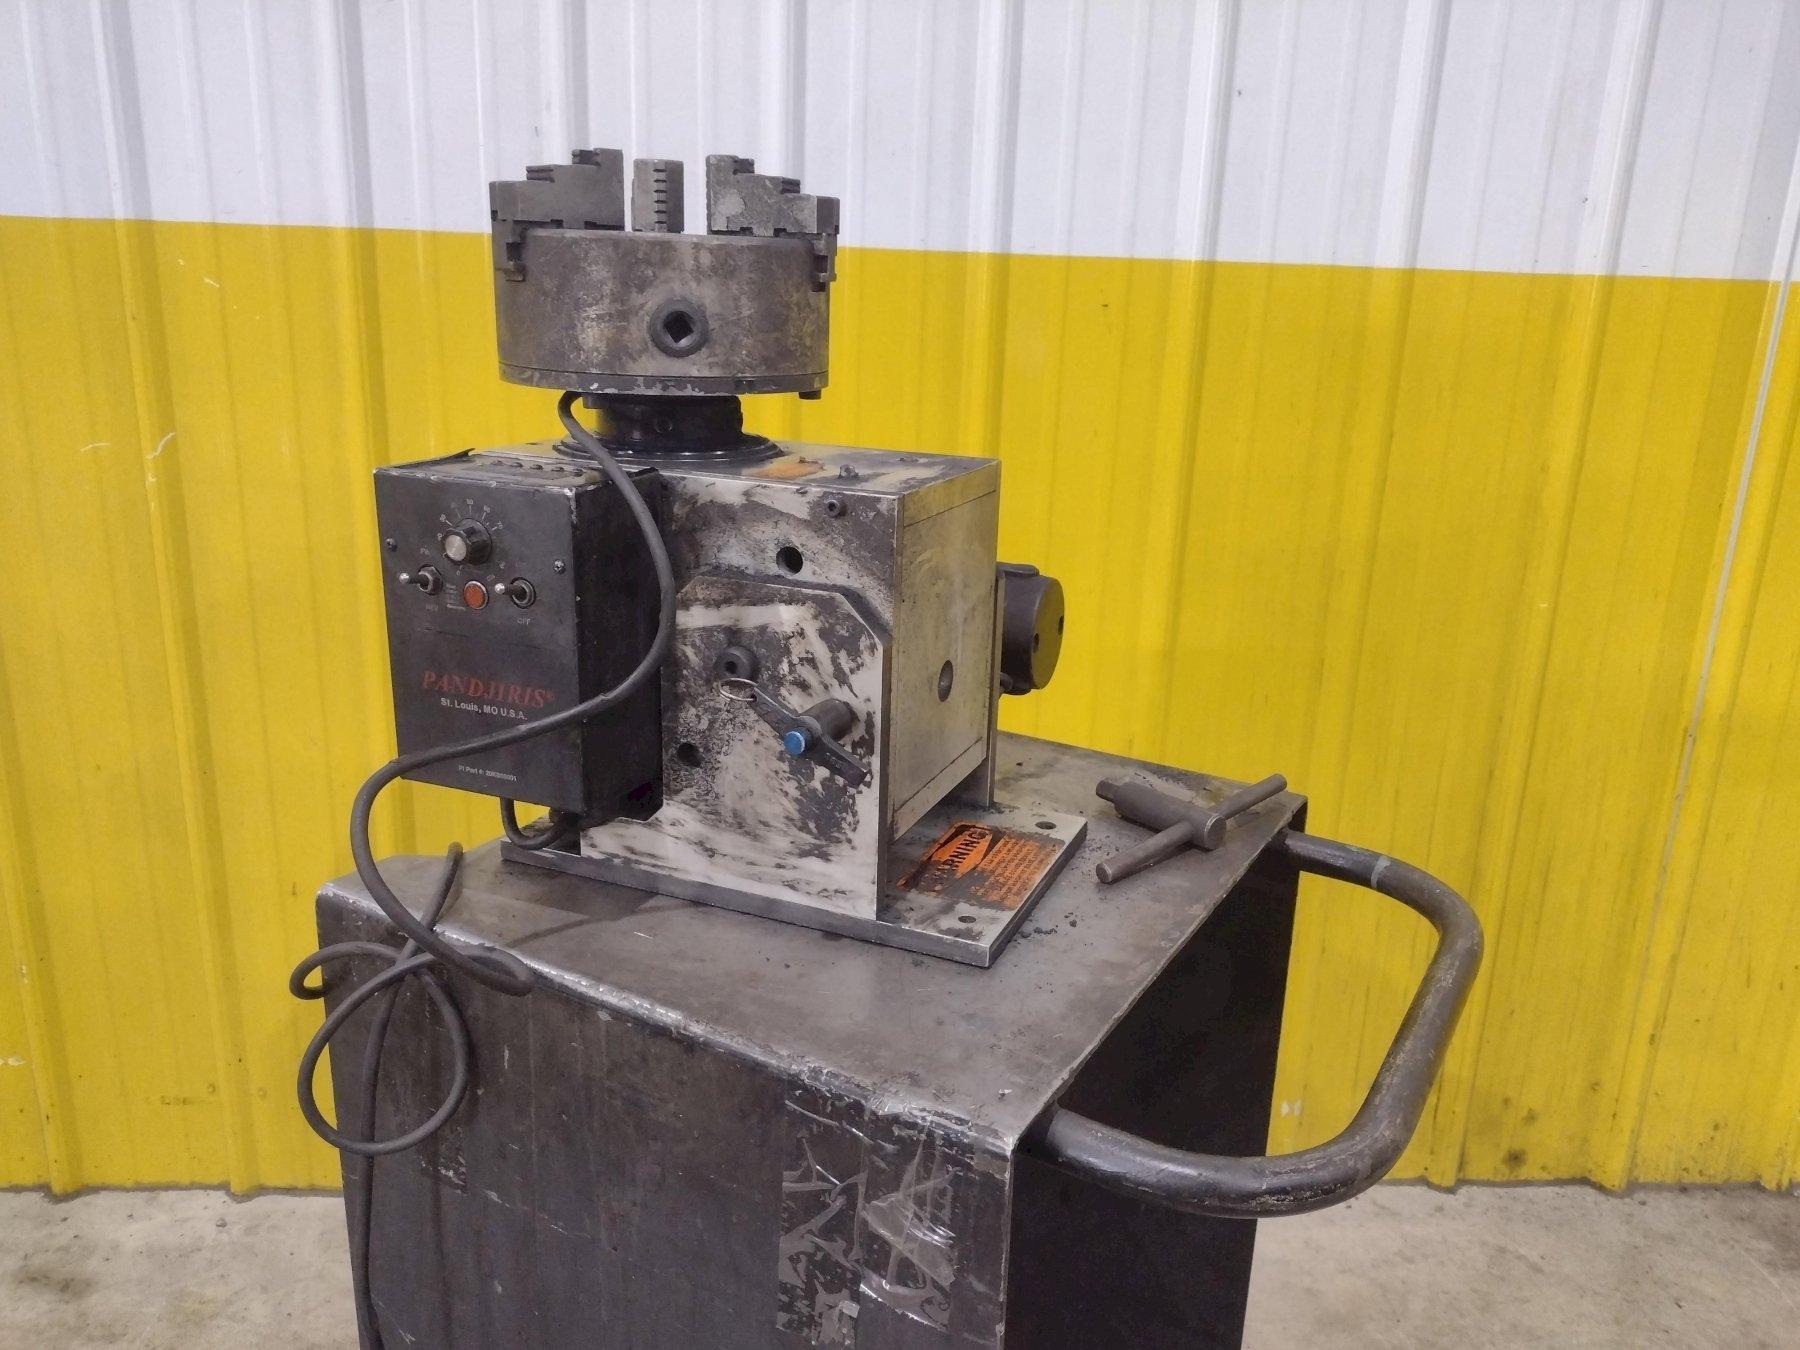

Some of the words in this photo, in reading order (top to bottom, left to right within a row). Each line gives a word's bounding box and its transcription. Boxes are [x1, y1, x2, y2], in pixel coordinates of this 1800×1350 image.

[440, 698, 453, 708] St.
[454, 699, 482, 713] Louis,
[483, 705, 498, 715] MO
[500, 708, 528, 720] U.S.A.
